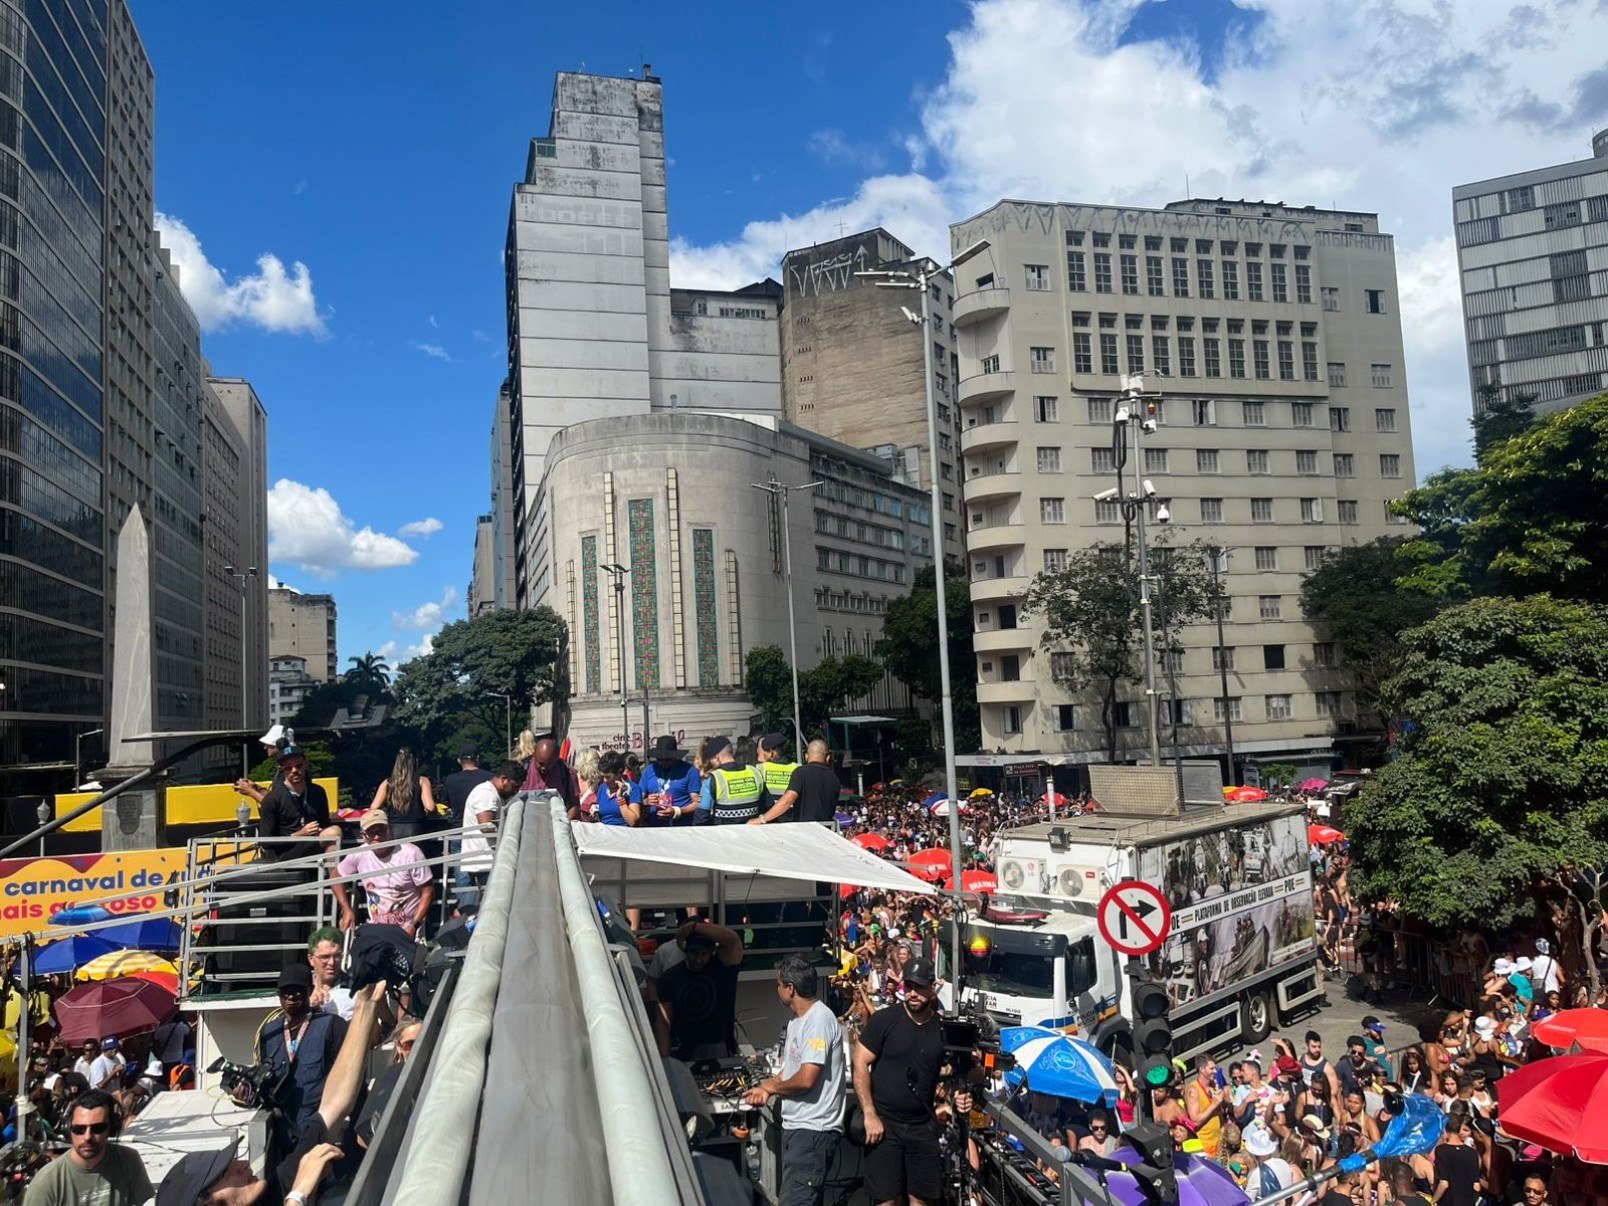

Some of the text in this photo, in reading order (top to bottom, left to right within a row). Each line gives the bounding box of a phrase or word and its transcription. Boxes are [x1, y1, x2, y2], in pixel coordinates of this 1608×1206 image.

[4, 870, 124, 896] carnaval
[131, 868, 164, 888] de
[0, 899, 43, 921] ais
[1194, 902, 1222, 922] PLATAFORMA
[1223, 900, 1230, 911] DE
[1231, 889, 1257, 909] OBSERVAÇÃO
[1284, 877, 1296, 893] POE
